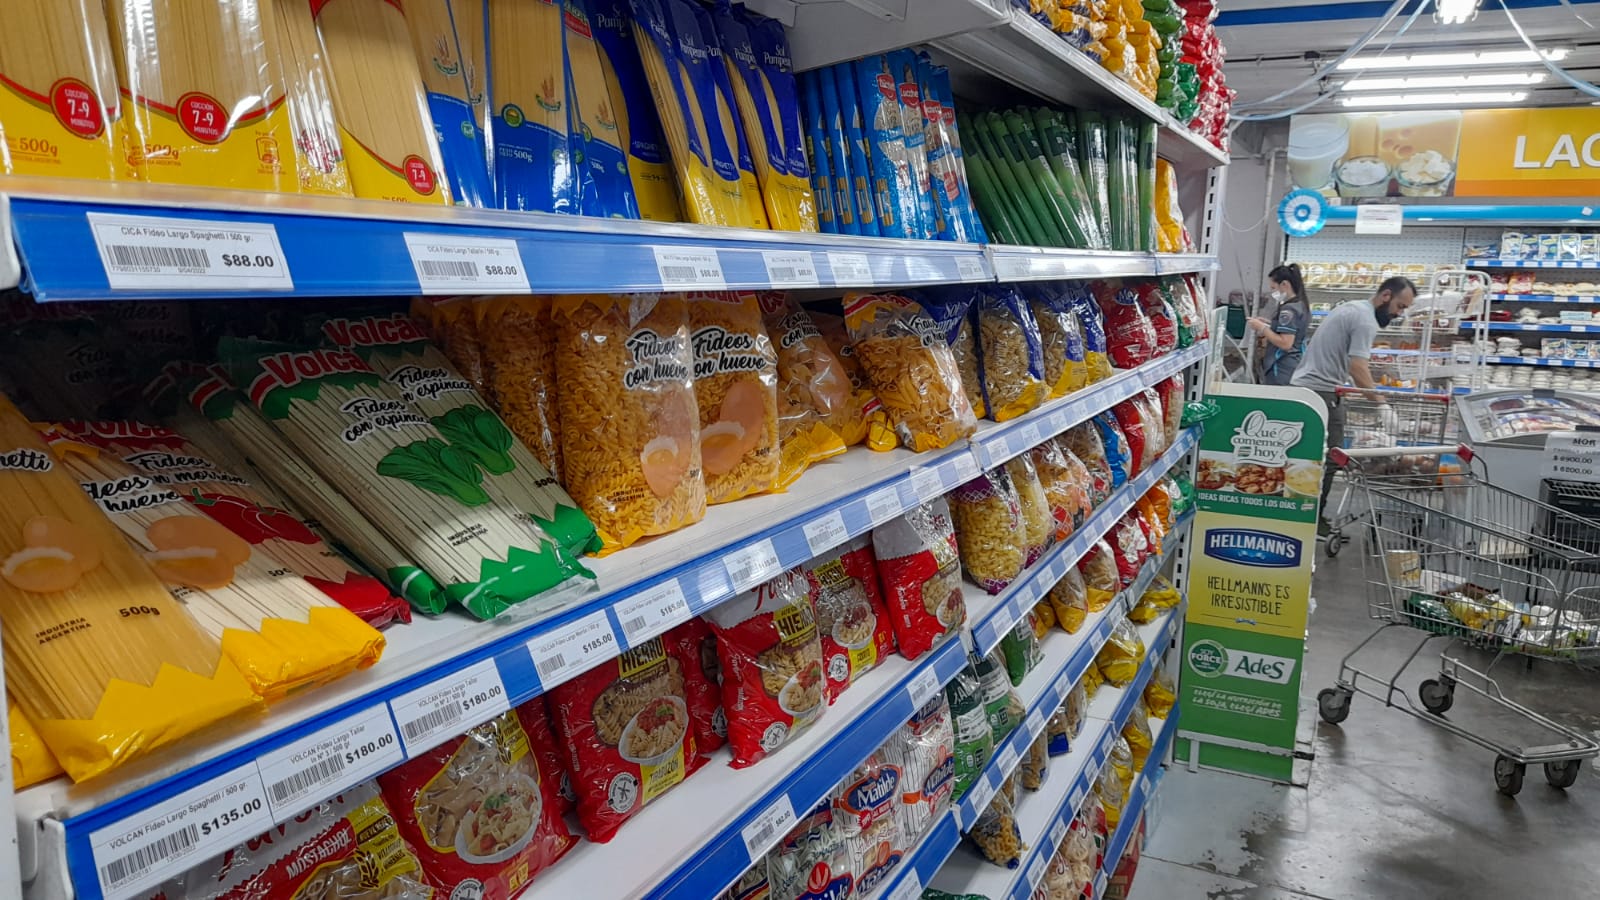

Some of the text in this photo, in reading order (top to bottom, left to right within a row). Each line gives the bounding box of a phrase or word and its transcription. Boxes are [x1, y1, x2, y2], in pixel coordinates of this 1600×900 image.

[775, 44, 786, 56] Sol
[67, 99, 90, 118] 7-9
[192, 110, 214, 126] 7-9
[19, 137, 58, 157] 500g
[145, 143, 179, 160] 500g
[513, 150, 533, 163] 500g
[120, 227, 142, 236] CICA
[143, 229, 166, 238] Fideo
[167, 230, 190, 240] Largo
[190, 231, 225, 242] Spaghetti
[222, 254, 275, 268] $88.00
[485, 265, 518, 275] $88.00
[691, 327, 753, 357] Fideos
[625, 363, 688, 387] con huevo
[694, 353, 766, 378] on huevo
[388, 364, 449, 390] Fideos
[342, 398, 406, 419] Fideos
[344, 420, 373, 443] con
[1232, 437, 1286, 448] comemos
[1198, 493, 1218, 501] IDEAS
[1218, 495, 1239, 503] RICAS
[1240, 497, 1263, 506] TODOS
[1265, 499, 1278, 507] LOS
[1279, 501, 1297, 510] DÍAS
[448, 523, 482, 541] INDUSTRIA
[452, 527, 489, 547] ARGENTINA
[1210, 534, 1296, 559] HELLMANN'S
[1275, 585, 1291, 600] ES
[118, 605, 161, 618] 500g
[1211, 594, 1283, 616] IRRESISTIBLE
[35, 616, 87, 638] INDUSTRIA
[39, 622, 92, 645] ARGENTINA
[582, 633, 613, 654] $185.00
[1191, 652, 1222, 664] FORCE
[1234, 655, 1285, 680] AdeS
[462, 685, 501, 711] $180.00
[290, 747, 316, 765] VOLCAN
[333, 733, 350, 746] Largo
[345, 733, 393, 764] $180.00
[857, 773, 895, 809] Matilde
[109, 826, 144, 849] VOLCAN
[145, 818, 167, 834] Fideo
[167, 810, 188, 825] Largo
[188, 793, 222, 813] Spaghetti
[225, 785, 238, 795] 500
[201, 798, 262, 836] $135.00
